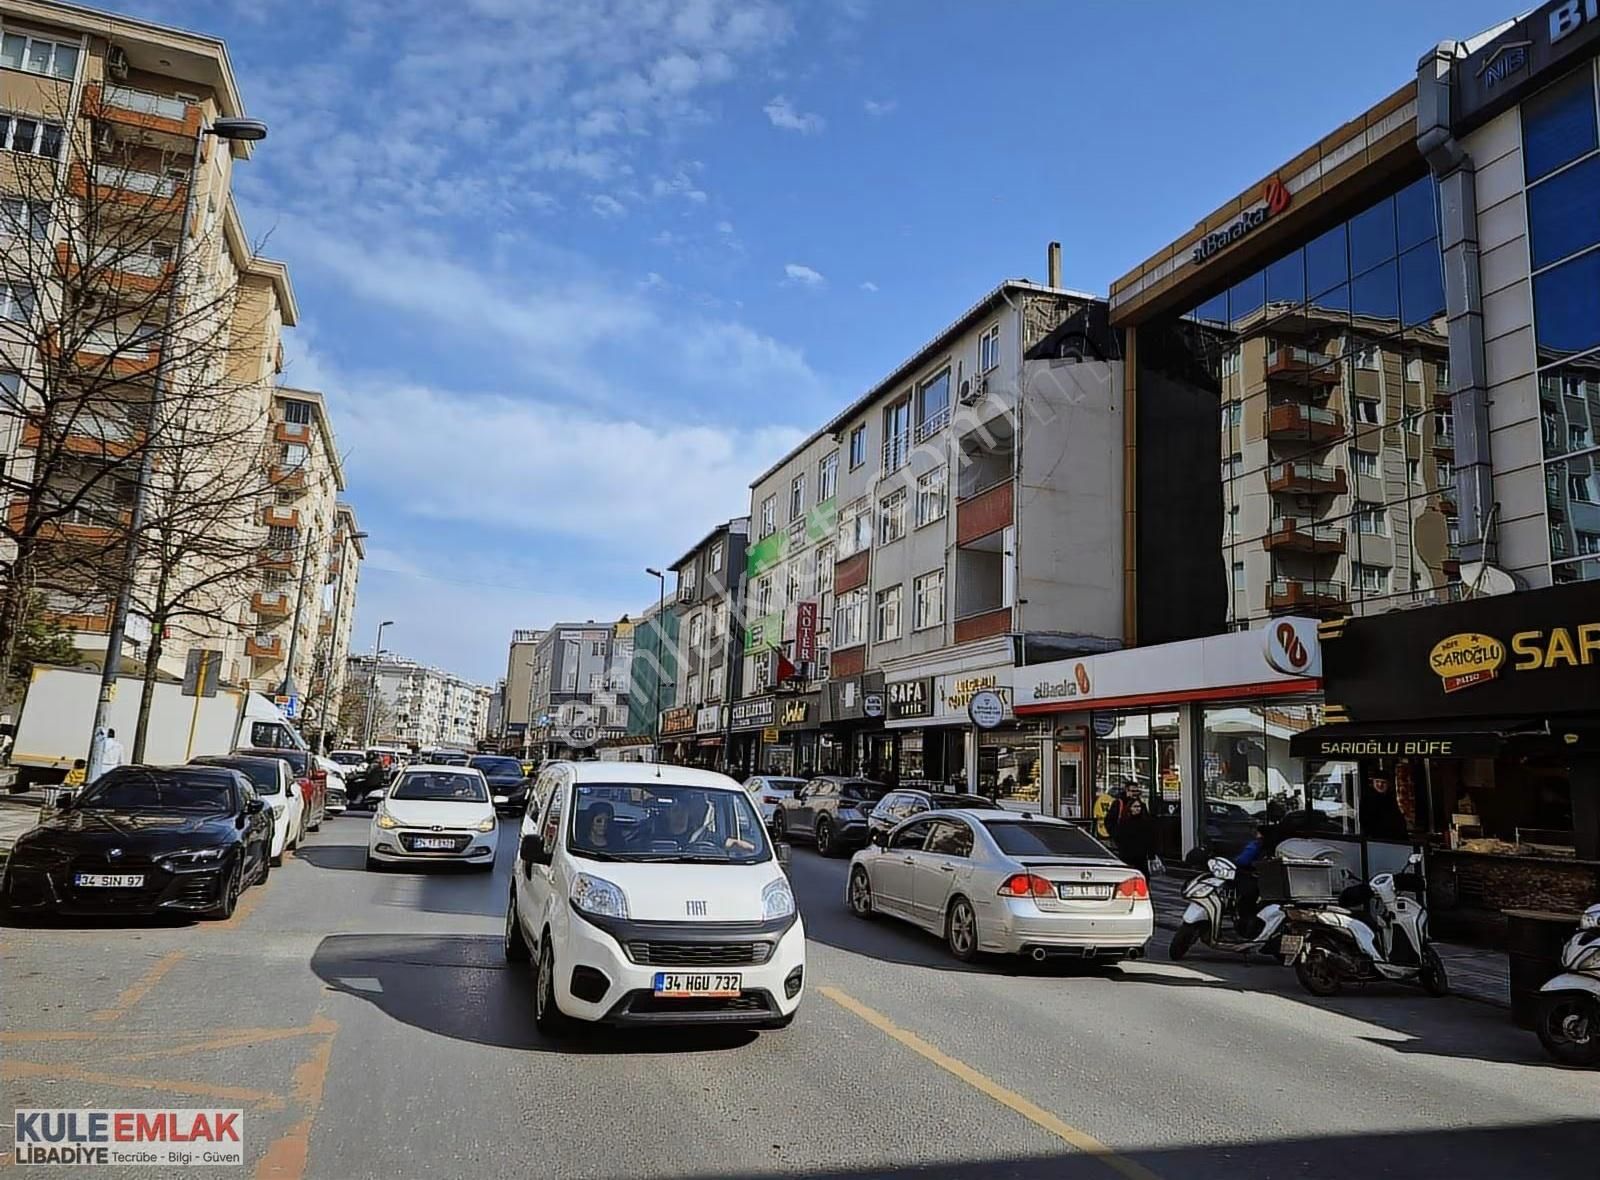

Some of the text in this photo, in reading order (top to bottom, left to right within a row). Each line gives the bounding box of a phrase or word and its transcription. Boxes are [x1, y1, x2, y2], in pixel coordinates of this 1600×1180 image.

[801, 605, 812, 659] NOTER
[1432, 644, 1500, 668] SARIOĞLU
[890, 682, 922, 703] SAFA
[1321, 739, 1453, 754] SARIOĞLU BÜFE
[81, 876, 142, 886] 34 SIN 97
[665, 975, 738, 990] 34 HGU 732
